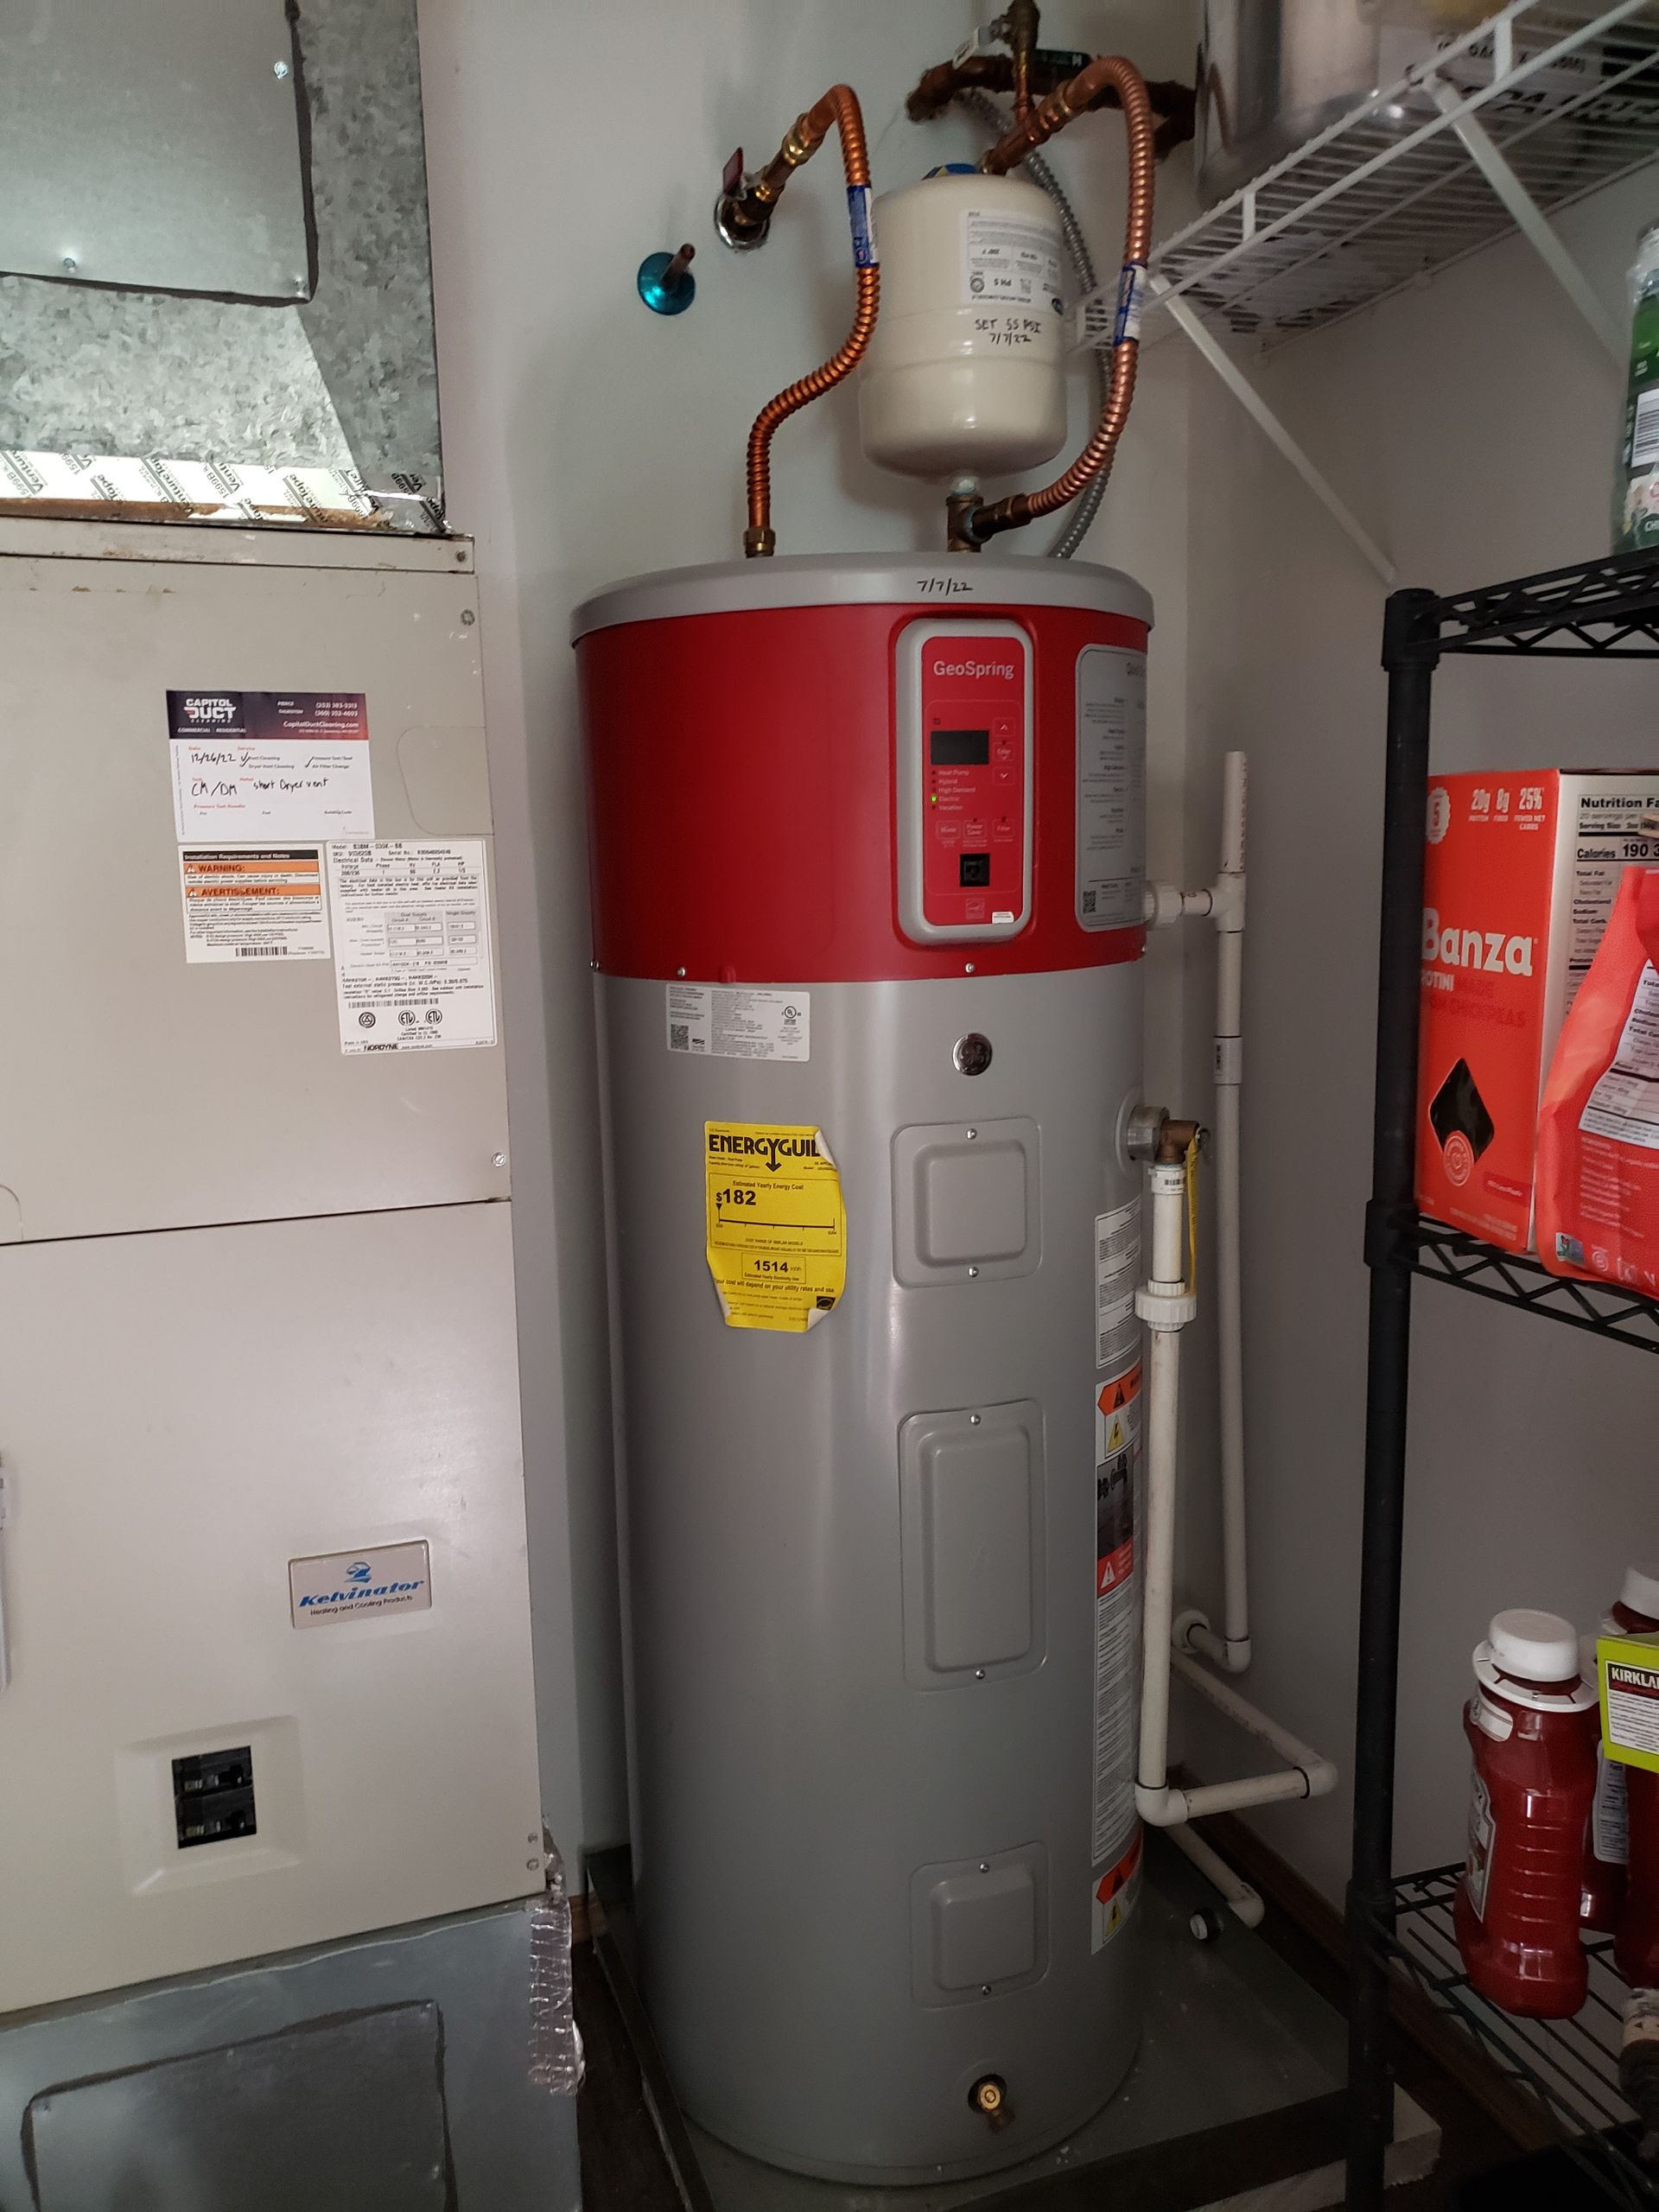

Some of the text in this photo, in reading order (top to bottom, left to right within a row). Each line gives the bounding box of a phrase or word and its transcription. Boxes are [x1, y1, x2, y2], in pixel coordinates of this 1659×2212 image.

[976, 319, 997, 330] SET
[989, 333, 1032, 346] 7/7/22
[207, 473, 230, 499] 1599B
[917, 577, 974, 596] 7/7/22
[933, 660, 1014, 680] GeoSpring
[186, 698, 232, 707] CAPITOL
[184, 707, 237, 719] DUCT
[191, 753, 237, 766] 12/26/22
[1471, 787, 1543, 814] 20g 8g 25%
[1581, 798, 1642, 808] Nutrition
[1577, 848, 1616, 858] Calories
[1624, 843, 1649, 857] 190
[201, 887, 280, 896] AVERTISSEMENT:
[1421, 906, 1534, 977] Banza
[1629, 1026, 1647, 1035] Total
[364, 1043, 398, 1052] NORDYNE
[715, 1188, 757, 1205] $182
[753, 1260, 788, 1273] 1514
[299, 1580, 422, 1607] Kelvinator
[310, 1605, 339, 1616] Heating
[354, 1599, 382, 1609] Cooling
[384, 1595, 412, 1605] Products
